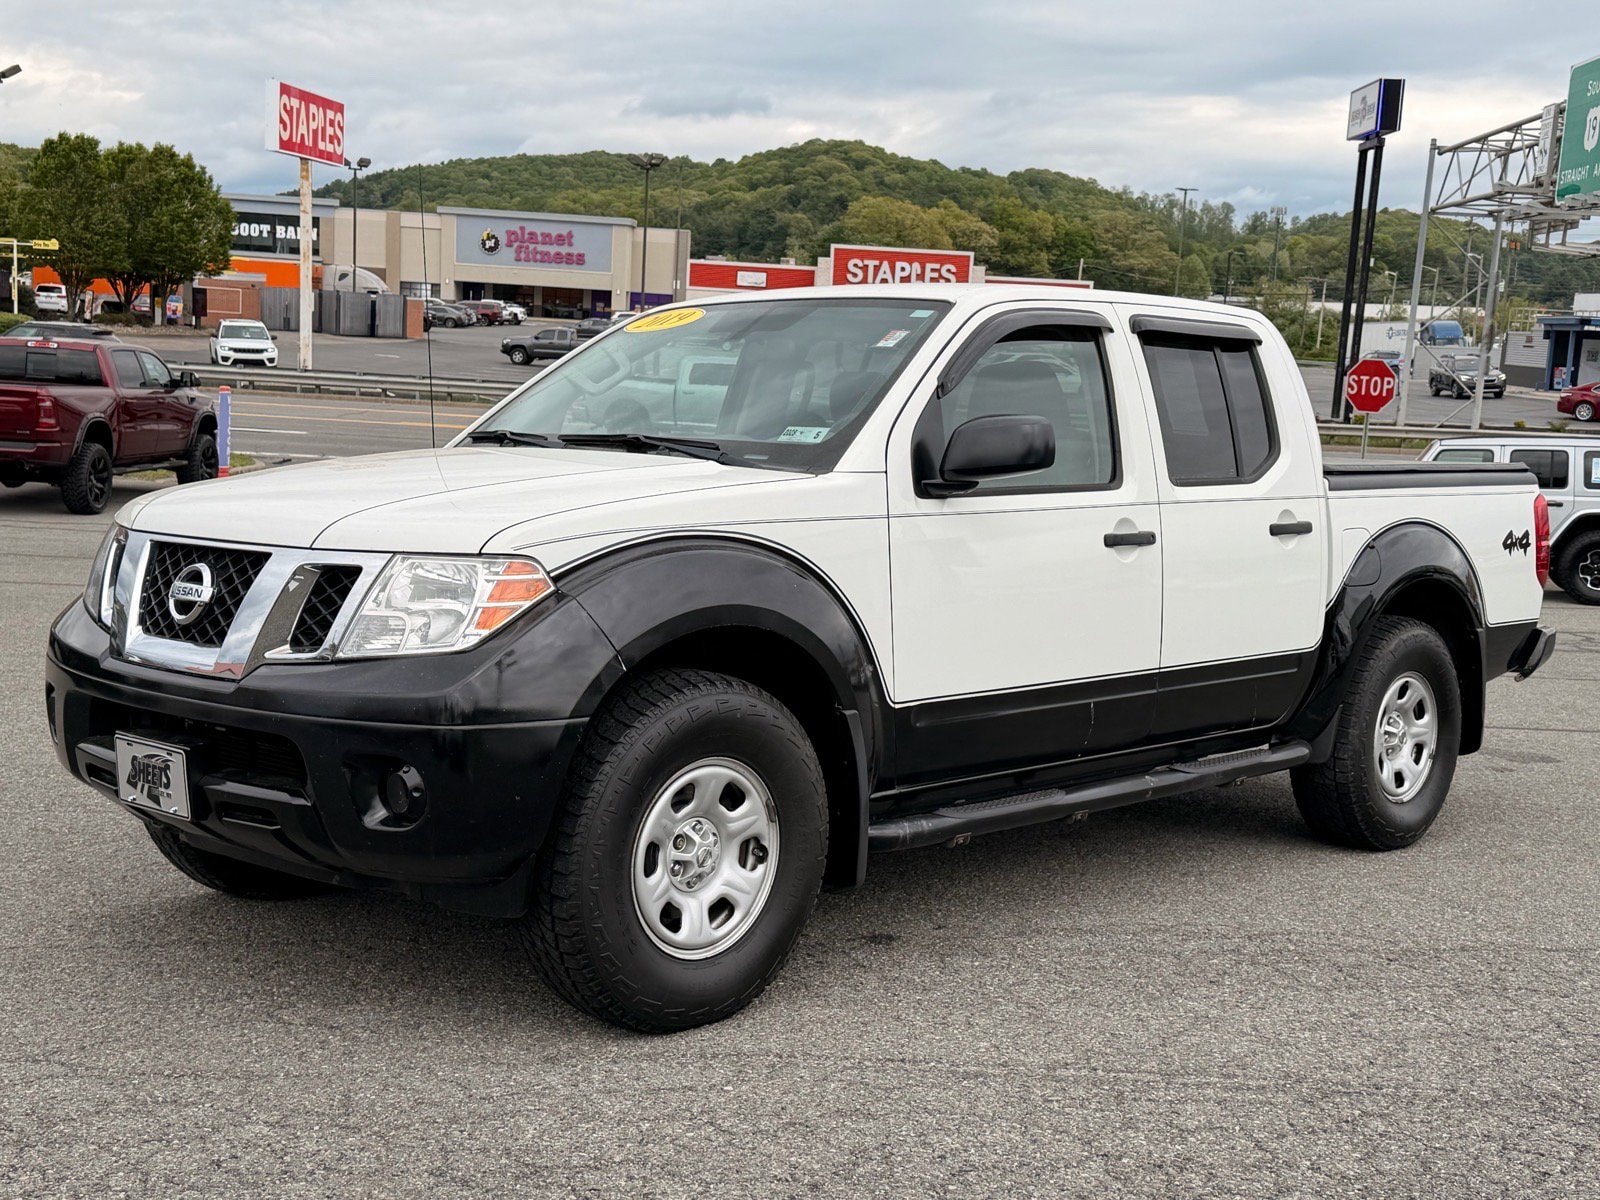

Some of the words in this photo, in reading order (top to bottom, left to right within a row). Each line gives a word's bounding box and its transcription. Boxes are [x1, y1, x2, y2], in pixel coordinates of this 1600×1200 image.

[280, 94, 343, 155] STAPLES
[1586, 116, 1598, 141] 19
[1560, 164, 1589, 184] STRAIGHT
[275, 225, 318, 240] BAN
[505, 226, 574, 247] planet
[514, 244, 586, 266] fitness
[846, 258, 957, 284] STAPLES
[1348, 374, 1394, 397] STOP
[813, 431, 822, 440] 5
[130, 754, 171, 790] SHEETS
